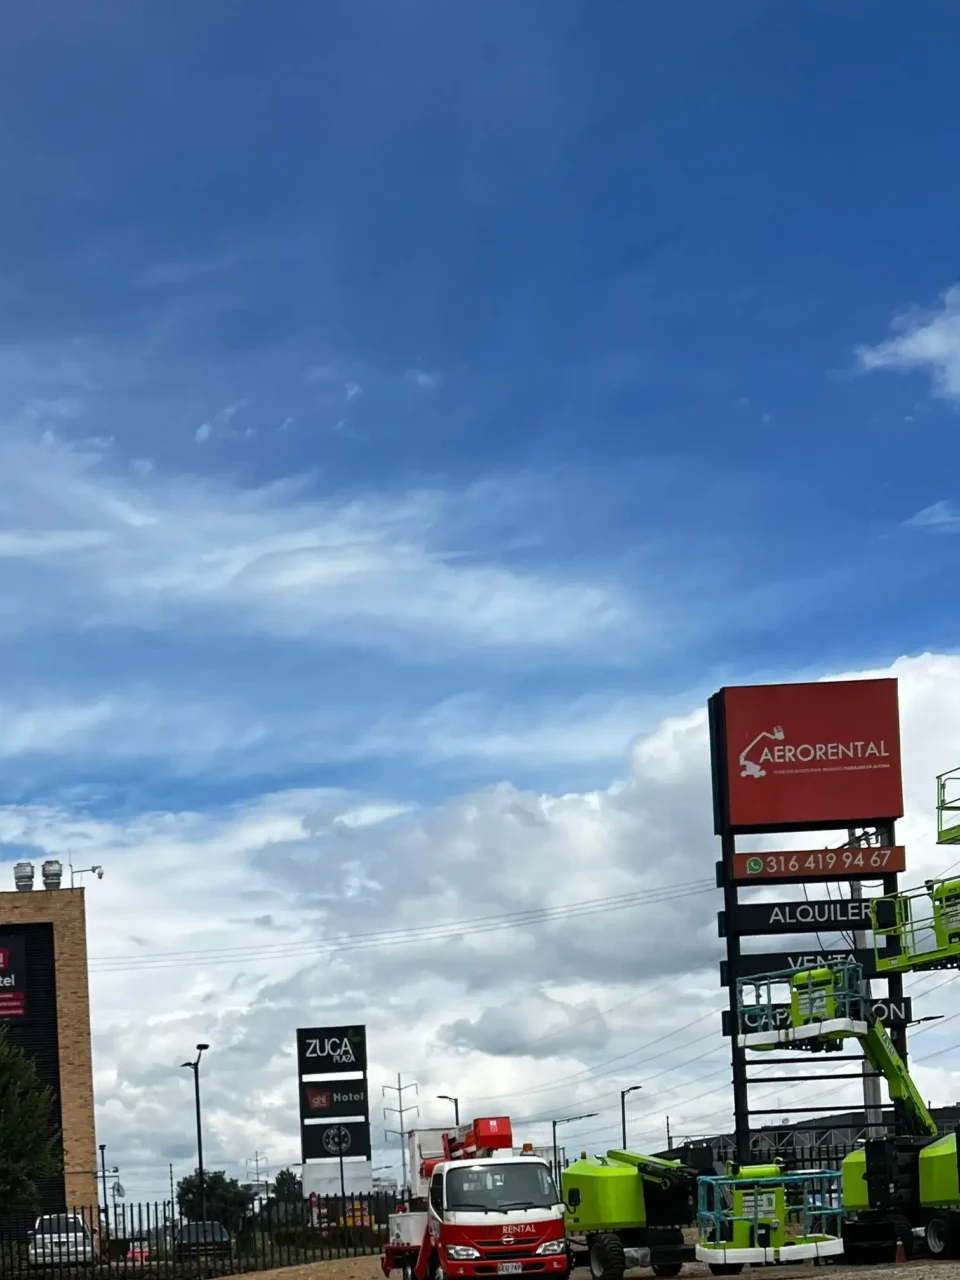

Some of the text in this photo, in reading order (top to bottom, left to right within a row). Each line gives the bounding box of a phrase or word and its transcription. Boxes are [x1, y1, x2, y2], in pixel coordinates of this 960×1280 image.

[759, 740, 890, 763] AERORENTAL
[766, 850, 891, 873] 316 419 94 67
[769, 903, 872, 924] ALQUILER
[305, 1038, 353, 1057] ZUCA
[333, 1055, 355, 1063] PLAZA
[333, 1092, 364, 1102] Hotel
[502, 1224, 536, 1234] RENTAL
